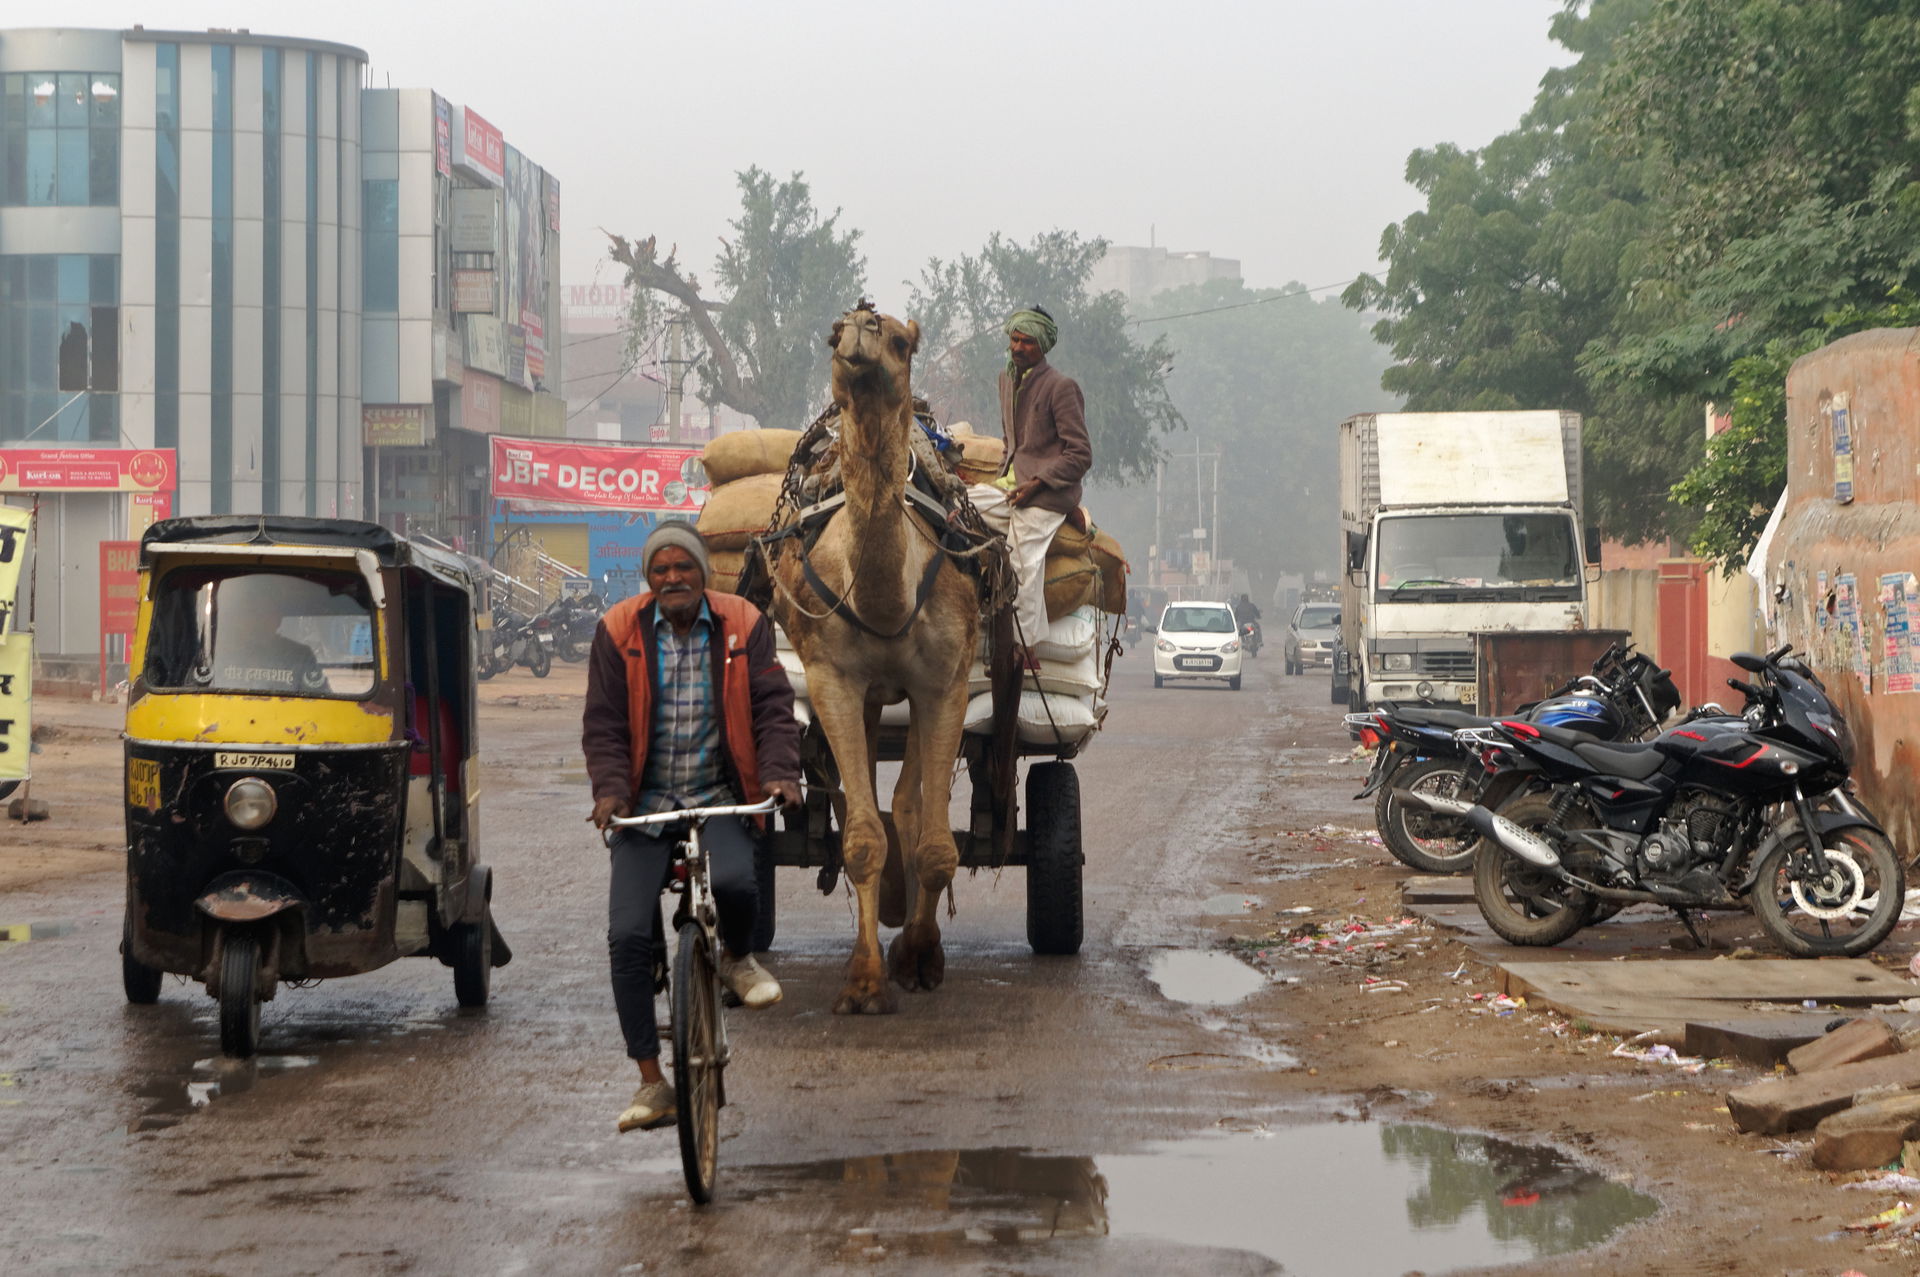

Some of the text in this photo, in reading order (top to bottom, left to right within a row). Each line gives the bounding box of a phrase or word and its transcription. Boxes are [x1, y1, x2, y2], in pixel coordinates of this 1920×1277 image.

[499, 460, 549, 486] JBF
[558, 465, 660, 494] DECOR
[584, 491, 607, 500] Complete
[608, 492, 623, 502] Range
[623, 493, 631, 502] Of
[108, 550, 137, 572] BHA
